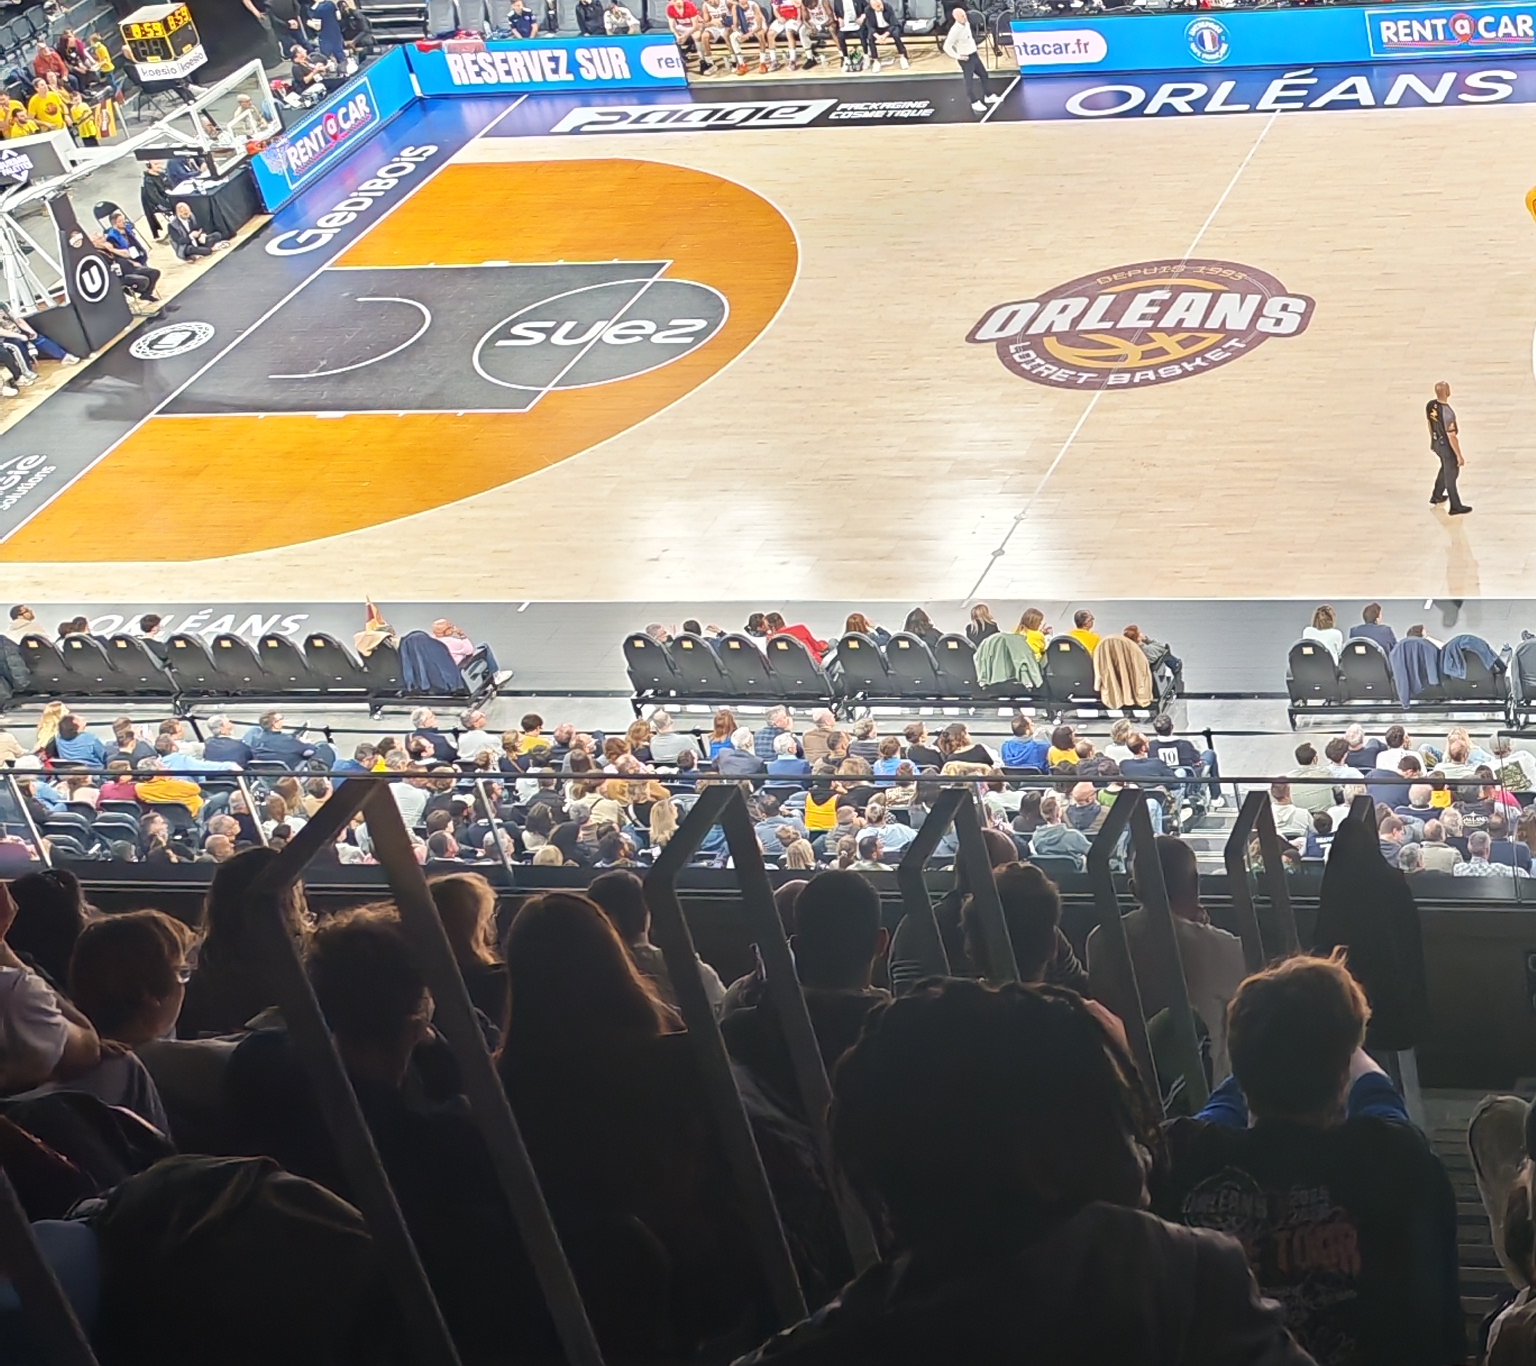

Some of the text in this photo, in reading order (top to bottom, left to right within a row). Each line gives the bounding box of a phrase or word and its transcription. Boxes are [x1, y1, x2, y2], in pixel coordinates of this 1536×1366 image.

[132, 22, 163, 39] 8:59
[167, 9, 190, 31] 8:59
[1380, 14, 1535, 45] RENT a CAR
[141, 66, 177, 78] koesio
[180, 53, 205, 73] koesio
[575, 46, 631, 81] SUR
[1065, 68, 1518, 117] ORLÉANS
[286, 124, 323, 171] RENT
[337, 93, 371, 130] CAR
[82, 265, 99, 286] U
[1096, 264, 1187, 286] DEPUIS
[974, 288, 1308, 342] ORLÉANS
[495, 314, 710, 348] suez
[1008, 337, 1248, 385] LOIRET BASKET
